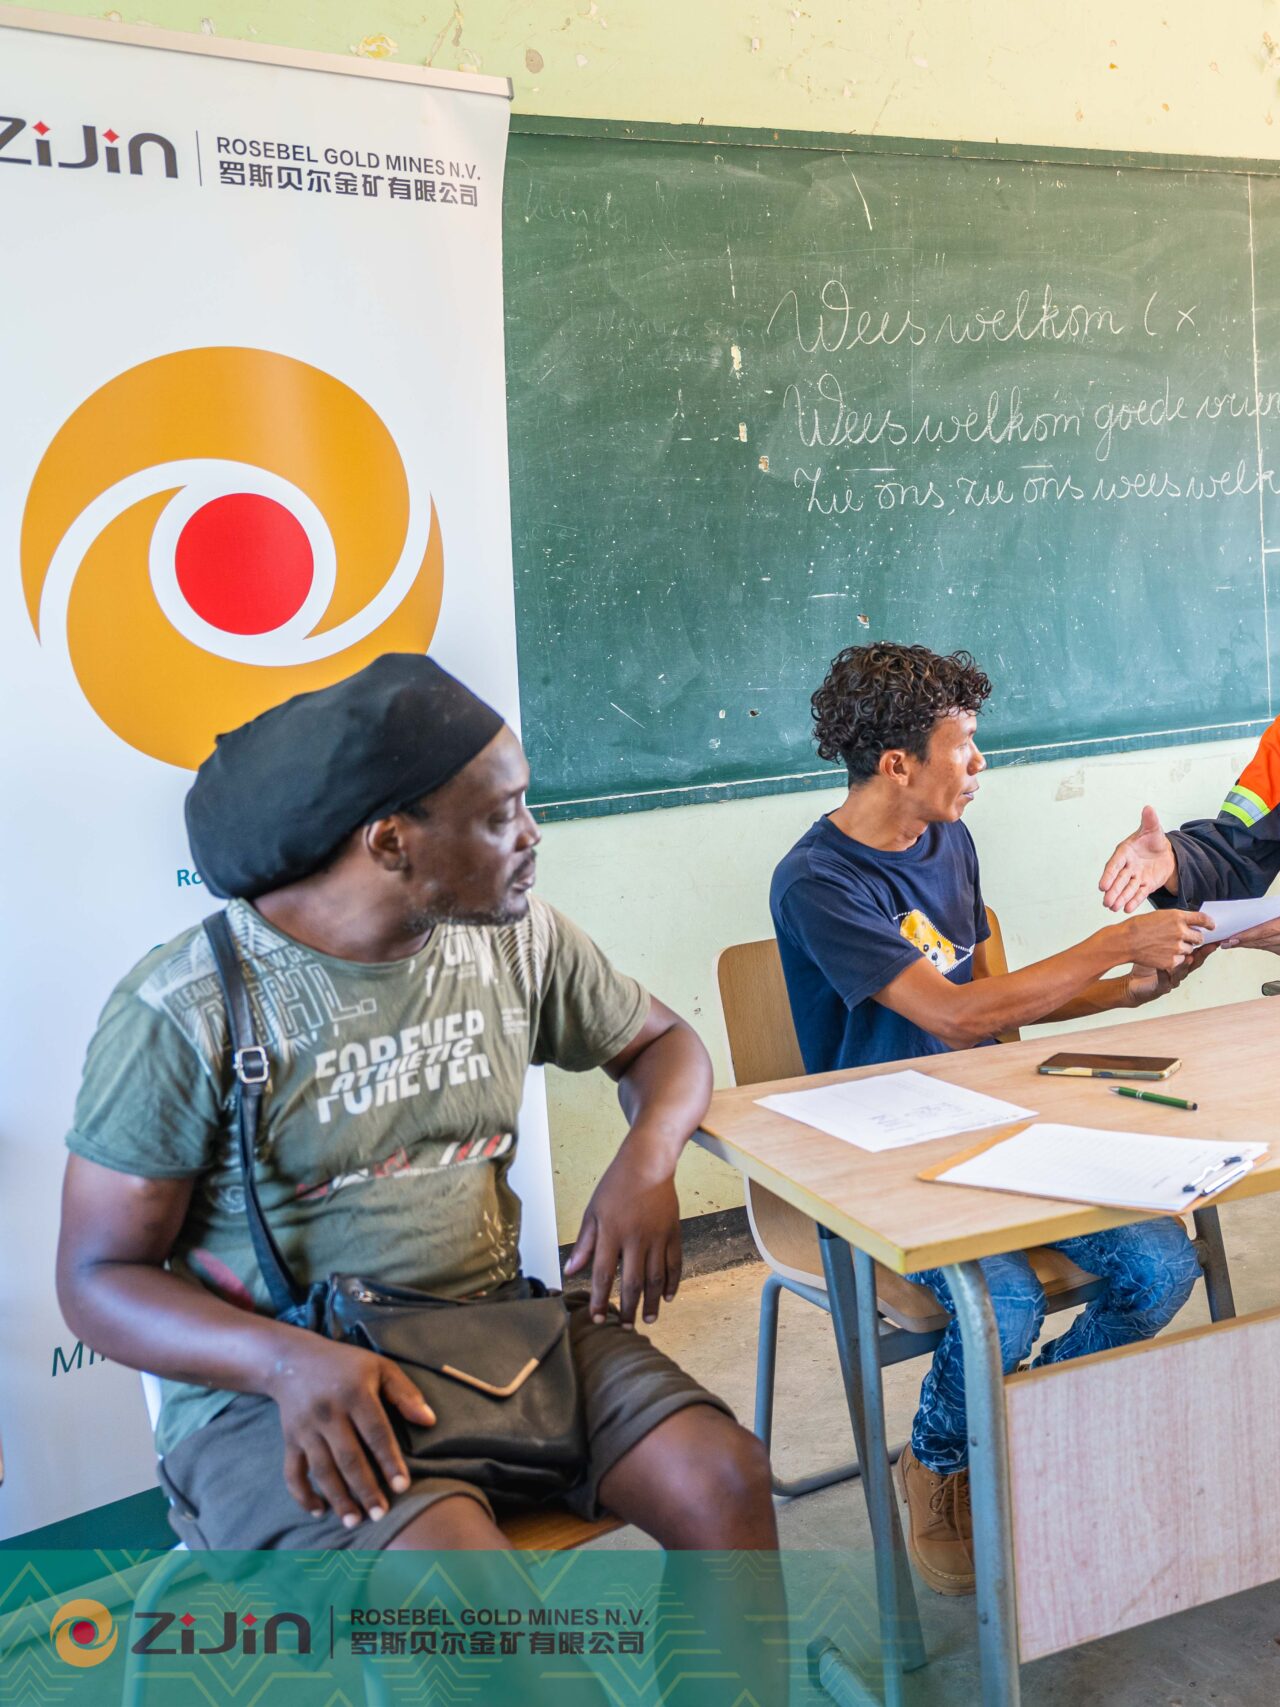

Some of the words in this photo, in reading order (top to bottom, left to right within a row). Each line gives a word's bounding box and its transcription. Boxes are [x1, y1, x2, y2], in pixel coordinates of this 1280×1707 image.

[216, 136, 319, 163] ROSEBEL
[324, 147, 381, 169] GOLD
[385, 153, 446, 177] MINES
[449, 160, 482, 181] N.V.
[218, 159, 479, 208] 罗斯贝尔金矿有限公司
[767, 279, 926, 352] Wees
[935, 284, 1125, 344] welkom
[783, 373, 908, 447] Wees
[911, 385, 1081, 446] welkom
[1094, 375, 1187, 461] goede
[1023, 474, 1084, 502] ons
[1092, 473, 1180, 501] wees
